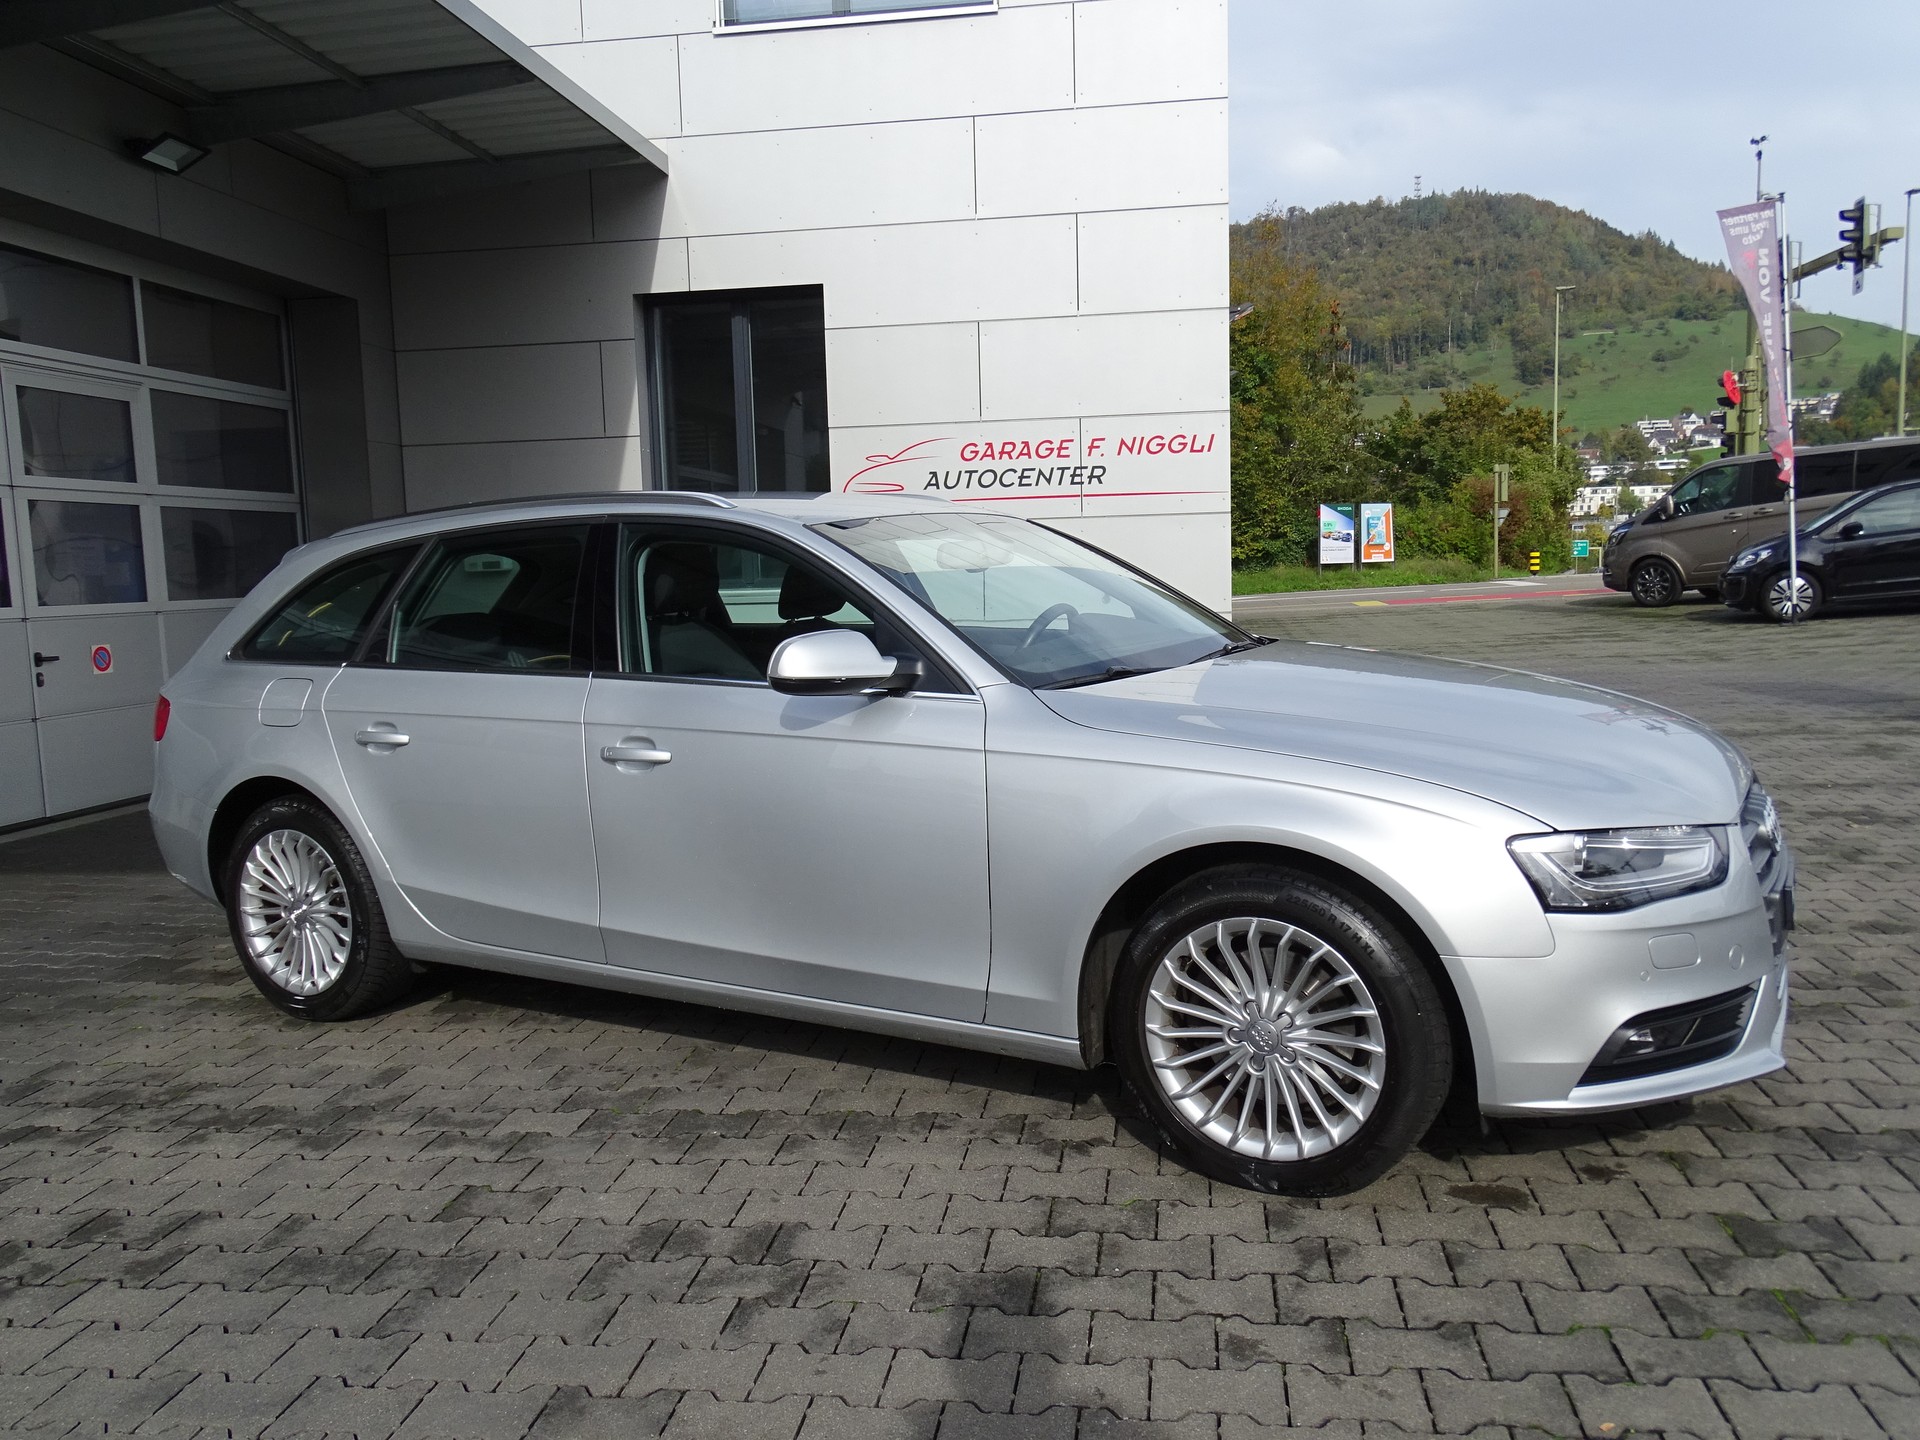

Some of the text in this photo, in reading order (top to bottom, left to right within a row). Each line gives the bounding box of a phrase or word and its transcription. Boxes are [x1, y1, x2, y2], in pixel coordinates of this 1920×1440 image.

[959, 433, 1216, 462] GARAGE F. NIGGLI
[923, 465, 1107, 491] AUTOCENTER
[1286, 893, 1326, 917] 225/50
[1328, 913, 1338, 924] R
[1340, 921, 1352, 933] 17
[1361, 941, 1375, 959] XL
